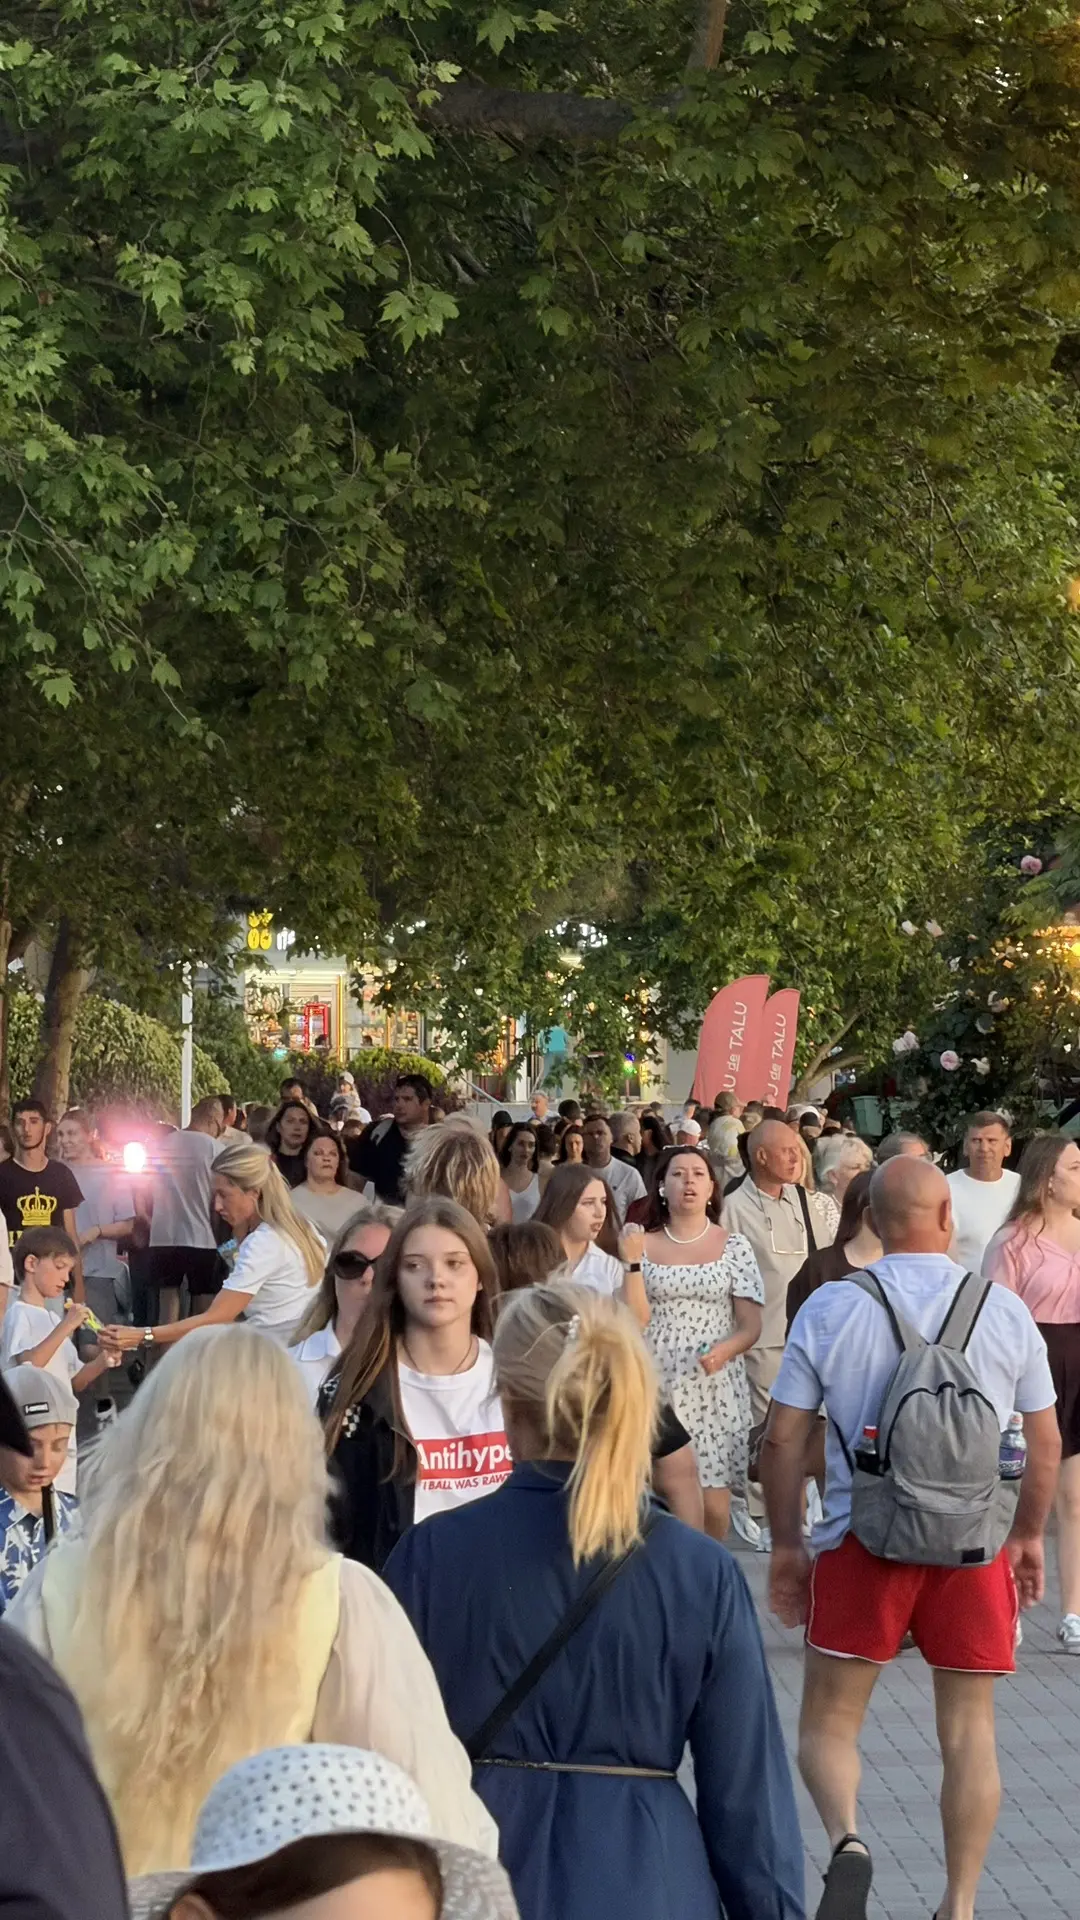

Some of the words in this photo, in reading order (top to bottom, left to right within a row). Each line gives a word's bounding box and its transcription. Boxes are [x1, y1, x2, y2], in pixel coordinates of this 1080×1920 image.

[729, 1002, 747, 1050] TALU
[771, 1013, 786, 1058] TALU
[727, 1054, 741, 1071] de
[769, 1063, 782, 1080] de
[723, 1074, 736, 1092] U
[455, 1477, 479, 1489] WAS
